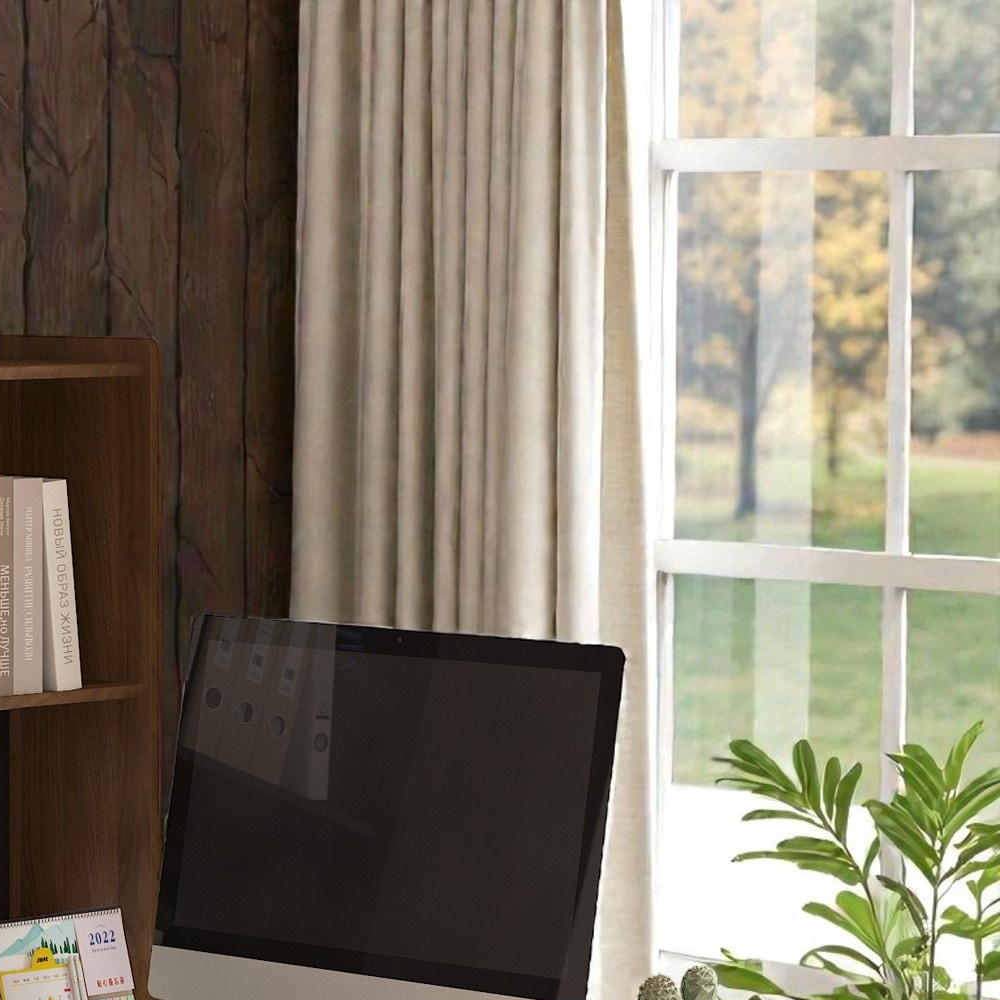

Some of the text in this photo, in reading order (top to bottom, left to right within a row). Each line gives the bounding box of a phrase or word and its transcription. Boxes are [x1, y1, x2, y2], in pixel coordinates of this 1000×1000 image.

[53, 508, 74, 665] НОВЫЙ ОБРАЗ ЖИЗНИ
[0, 636, 10, 677] ЛУЧШЕ
[88, 930, 116, 945] 2022
